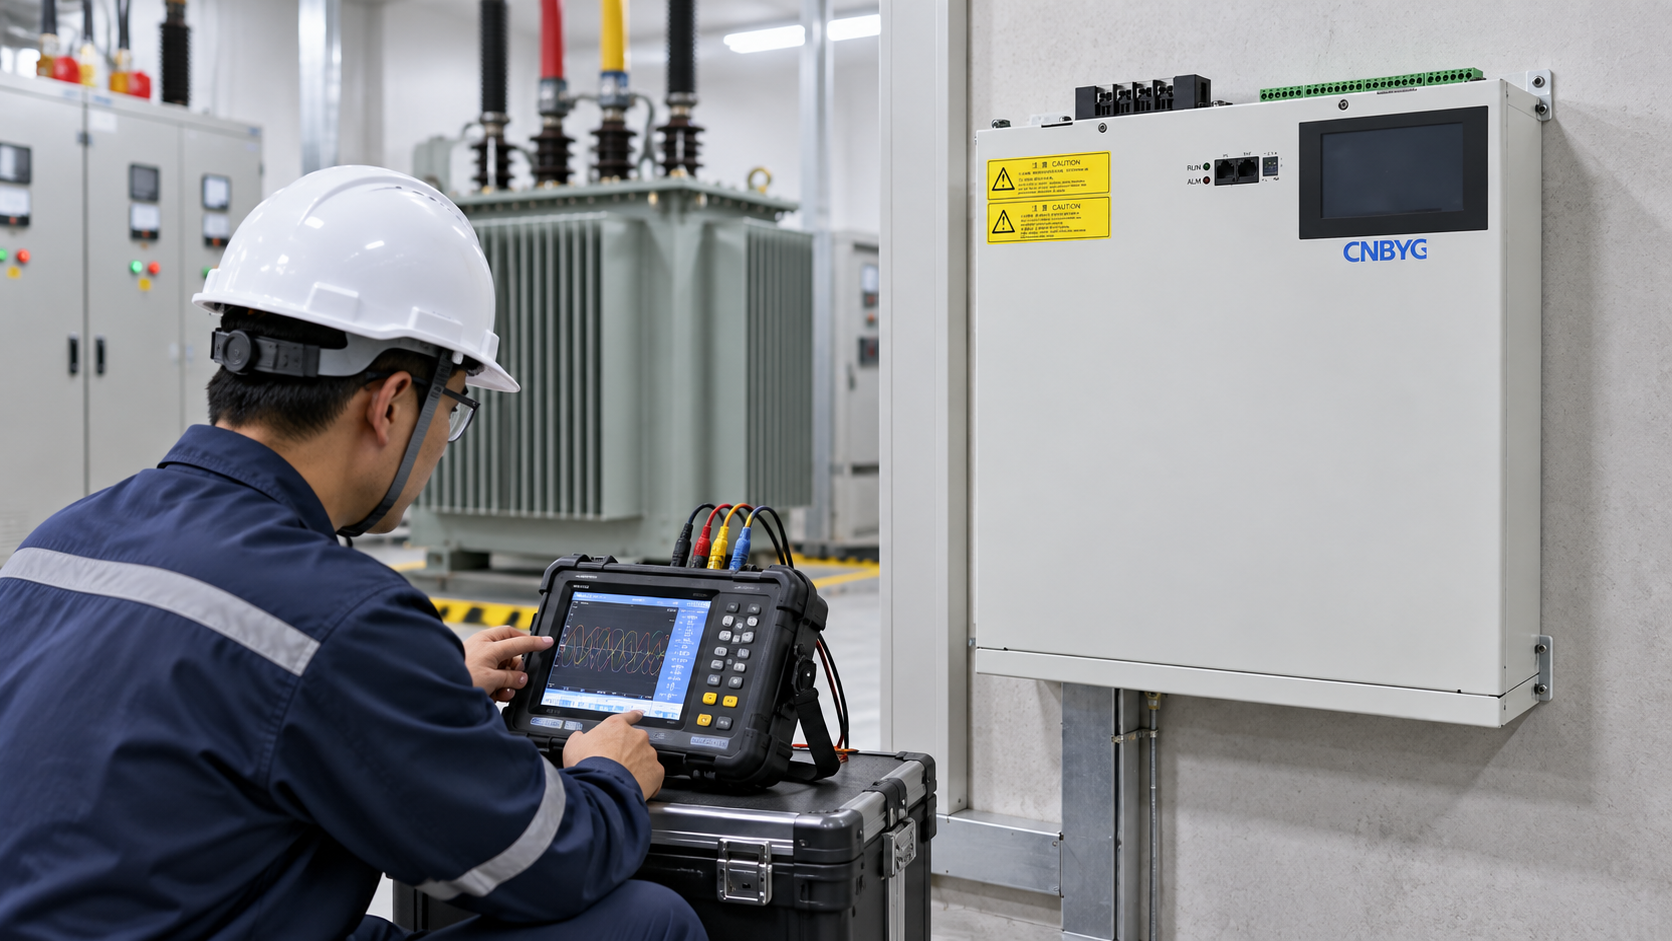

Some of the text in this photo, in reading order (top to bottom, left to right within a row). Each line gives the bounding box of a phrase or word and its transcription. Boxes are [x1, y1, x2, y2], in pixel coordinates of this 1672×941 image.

[1052, 159, 1081, 167] CAUTION
[1052, 203, 1081, 211] CAUTION
[1343, 238, 1427, 262] CNBYG
